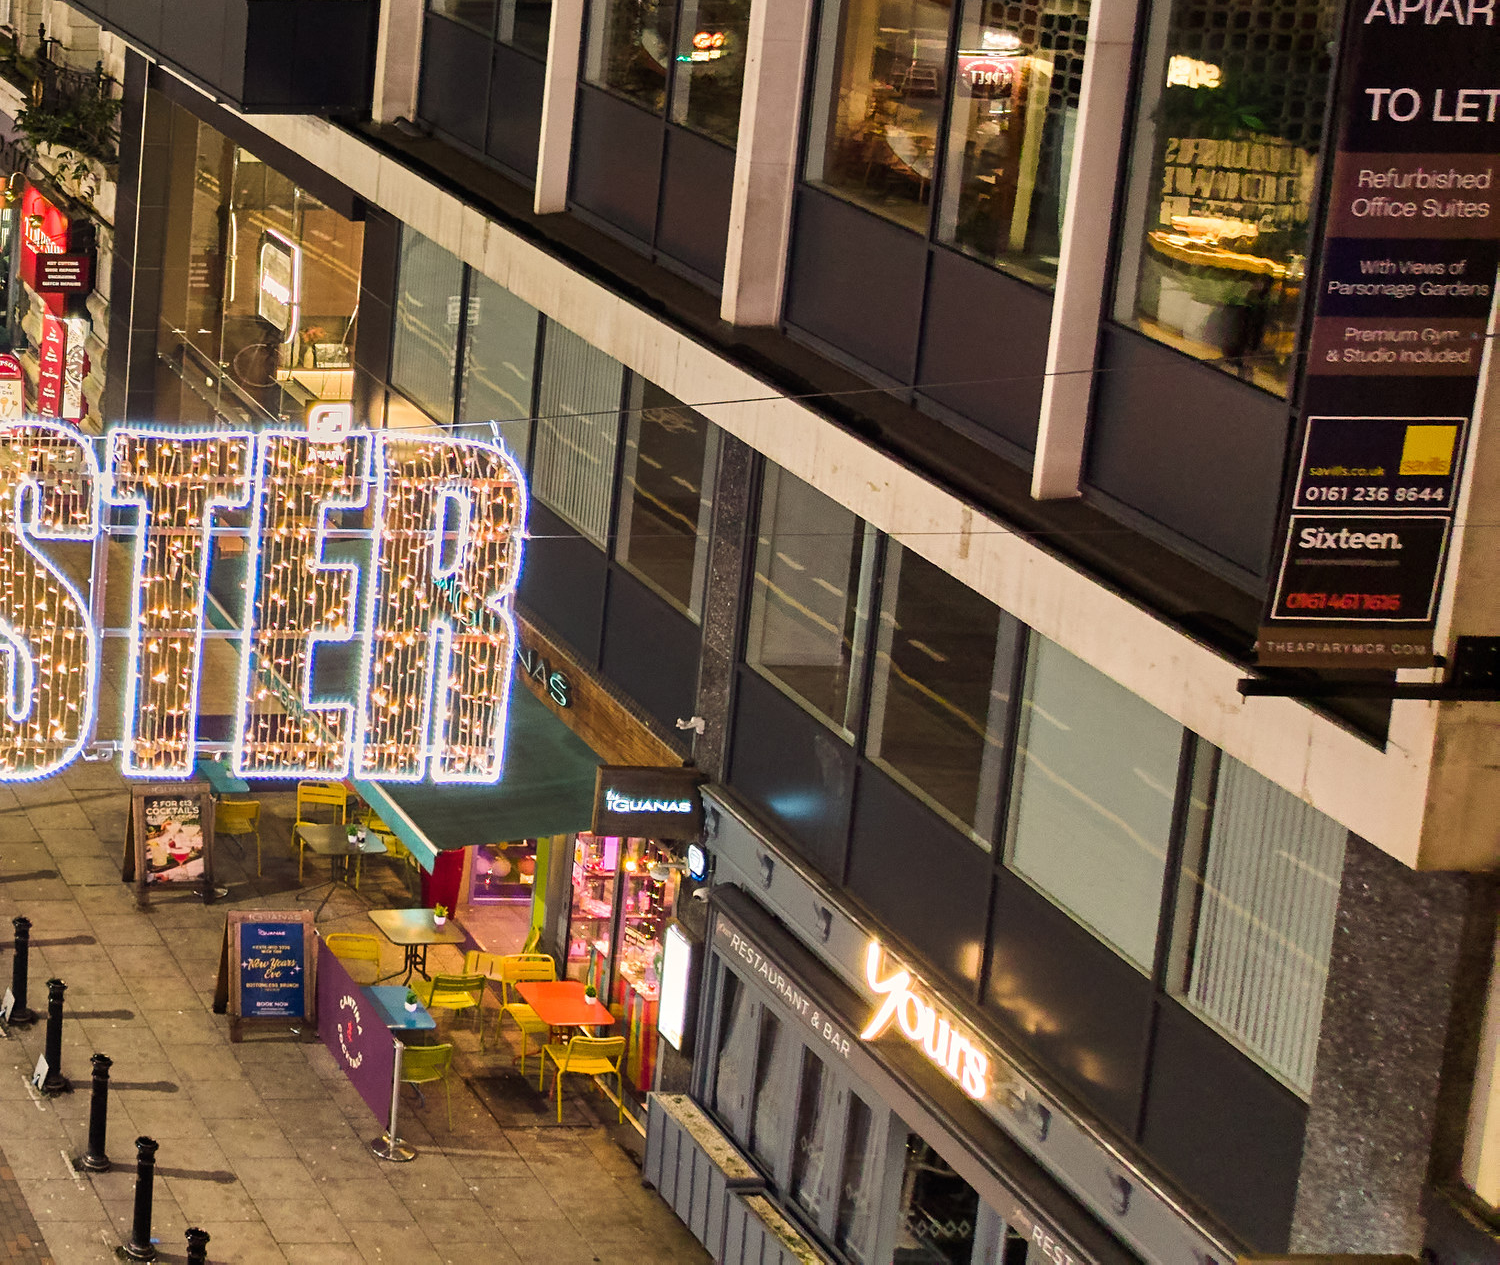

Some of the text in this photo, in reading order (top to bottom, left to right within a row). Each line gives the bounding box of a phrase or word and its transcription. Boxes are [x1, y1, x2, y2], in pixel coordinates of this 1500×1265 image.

[1365, 88, 1500, 123] TO LET
[1358, 168, 1492, 189] Refurbished
[1351, 196, 1490, 217] Office Suites
[1360, 259, 1467, 275] With Views of
[1328, 281, 1490, 298] Parsonage Gardens
[1344, 327, 1460, 344] Premium Gym
[1326, 348, 1472, 363] & Studio Included
[1402, 457, 1448, 473] savills
[1306, 487, 1444, 502] 0161 236 8644
[1299, 527, 1403, 550] Sixteen.
[145, 806, 199, 815] COCKTAILS
[153, 800, 158, 808] 2
[607, 799, 692, 813] IGUANAS
[248, 913, 302, 921] IGUANAS
[247, 957, 296, 970] New Years
[263, 968, 282, 979] Eve
[730, 934, 851, 1058] RESTAURANT & BAR
[340, 995, 363, 1035] CANTINA
[861, 942, 988, 1099] Yours
